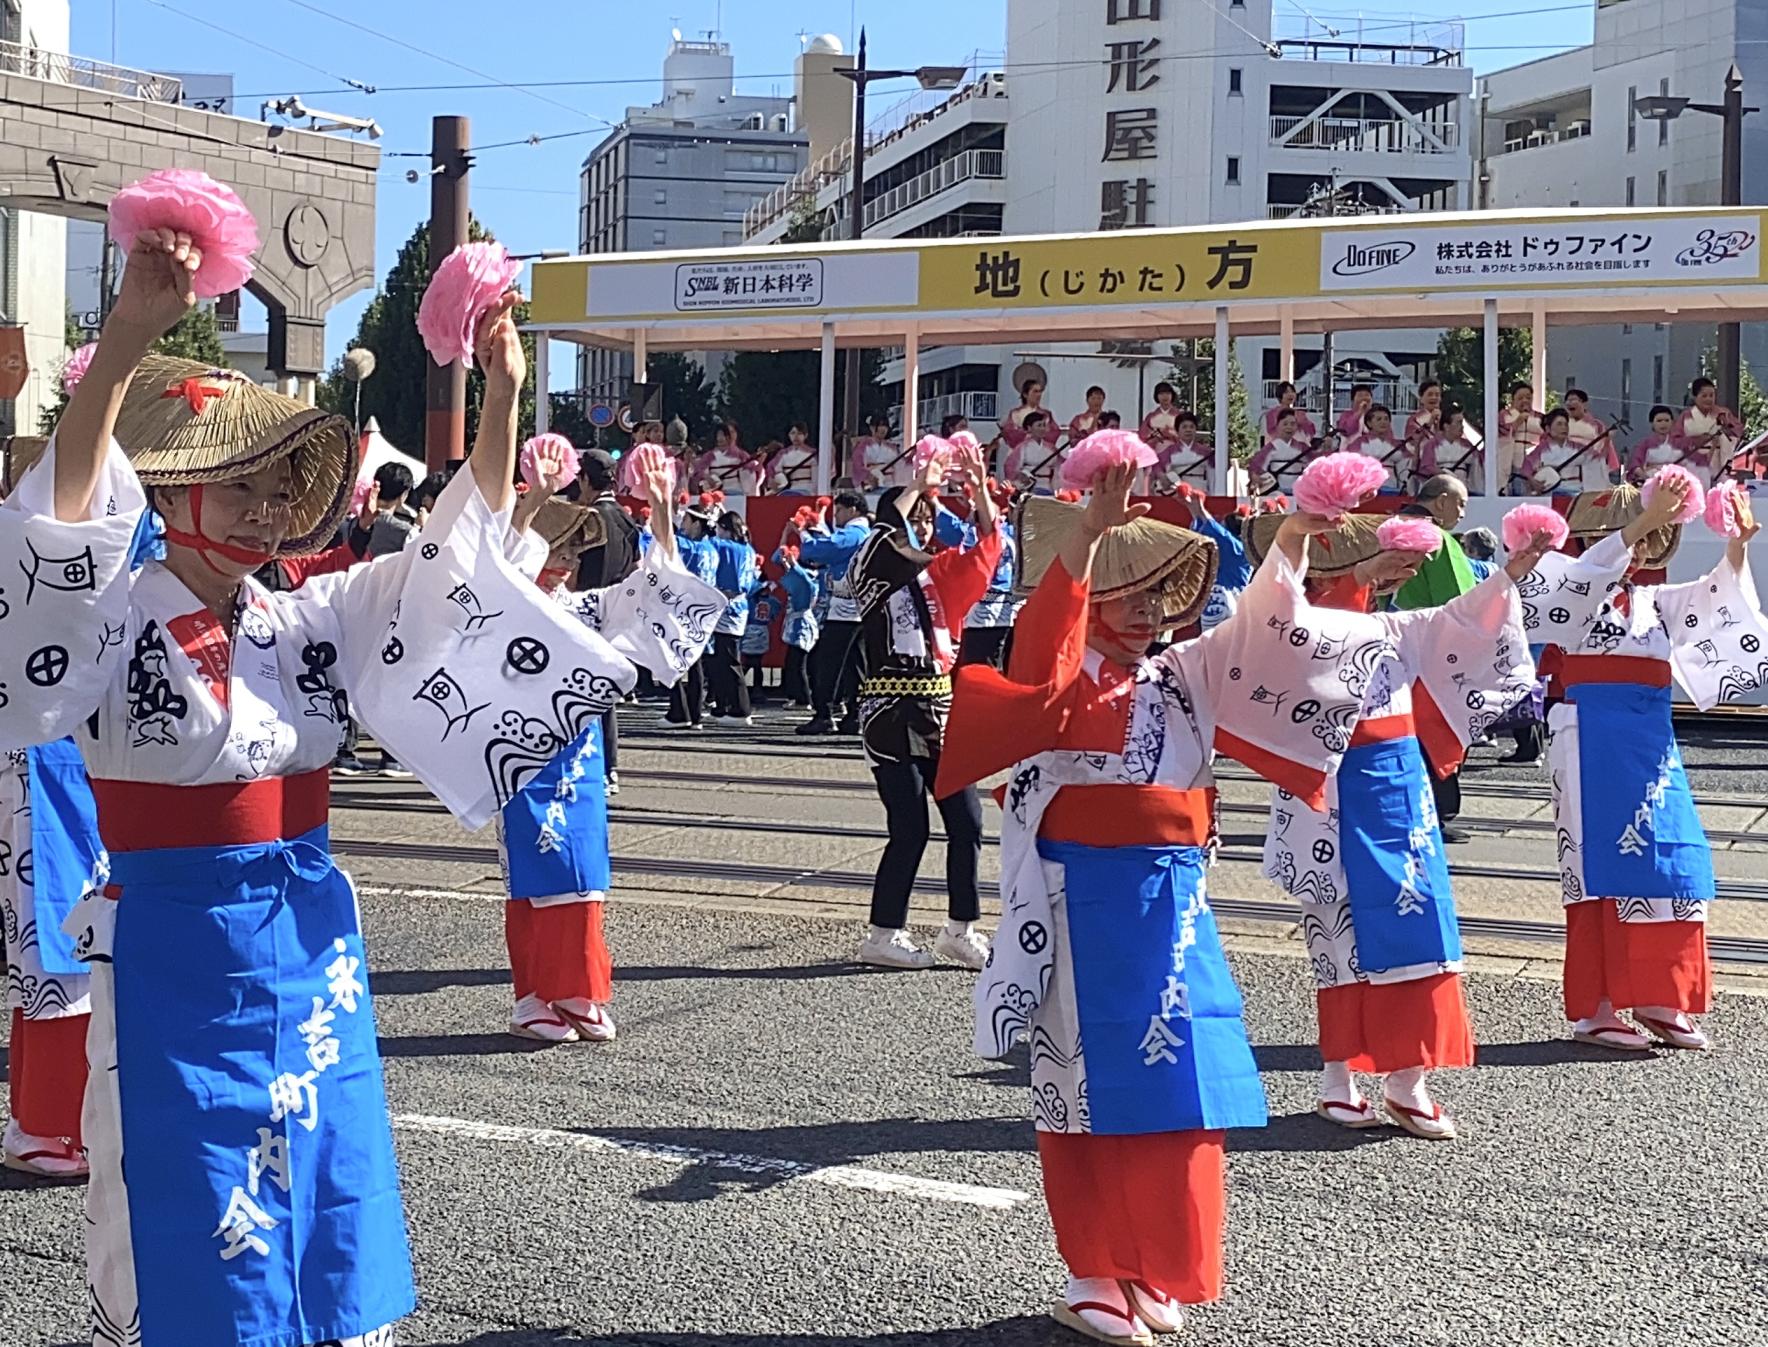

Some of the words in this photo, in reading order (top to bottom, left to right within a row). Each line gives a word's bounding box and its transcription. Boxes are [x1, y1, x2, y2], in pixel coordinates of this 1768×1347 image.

[1437, 239, 1513, 261] 株式会社
[1522, 233, 1652, 258] ドゥファイン
[684, 275, 719, 297] SNBL
[722, 273, 814, 295] 新日本科学
[211, 937, 363, 1261] 永吉町内会
